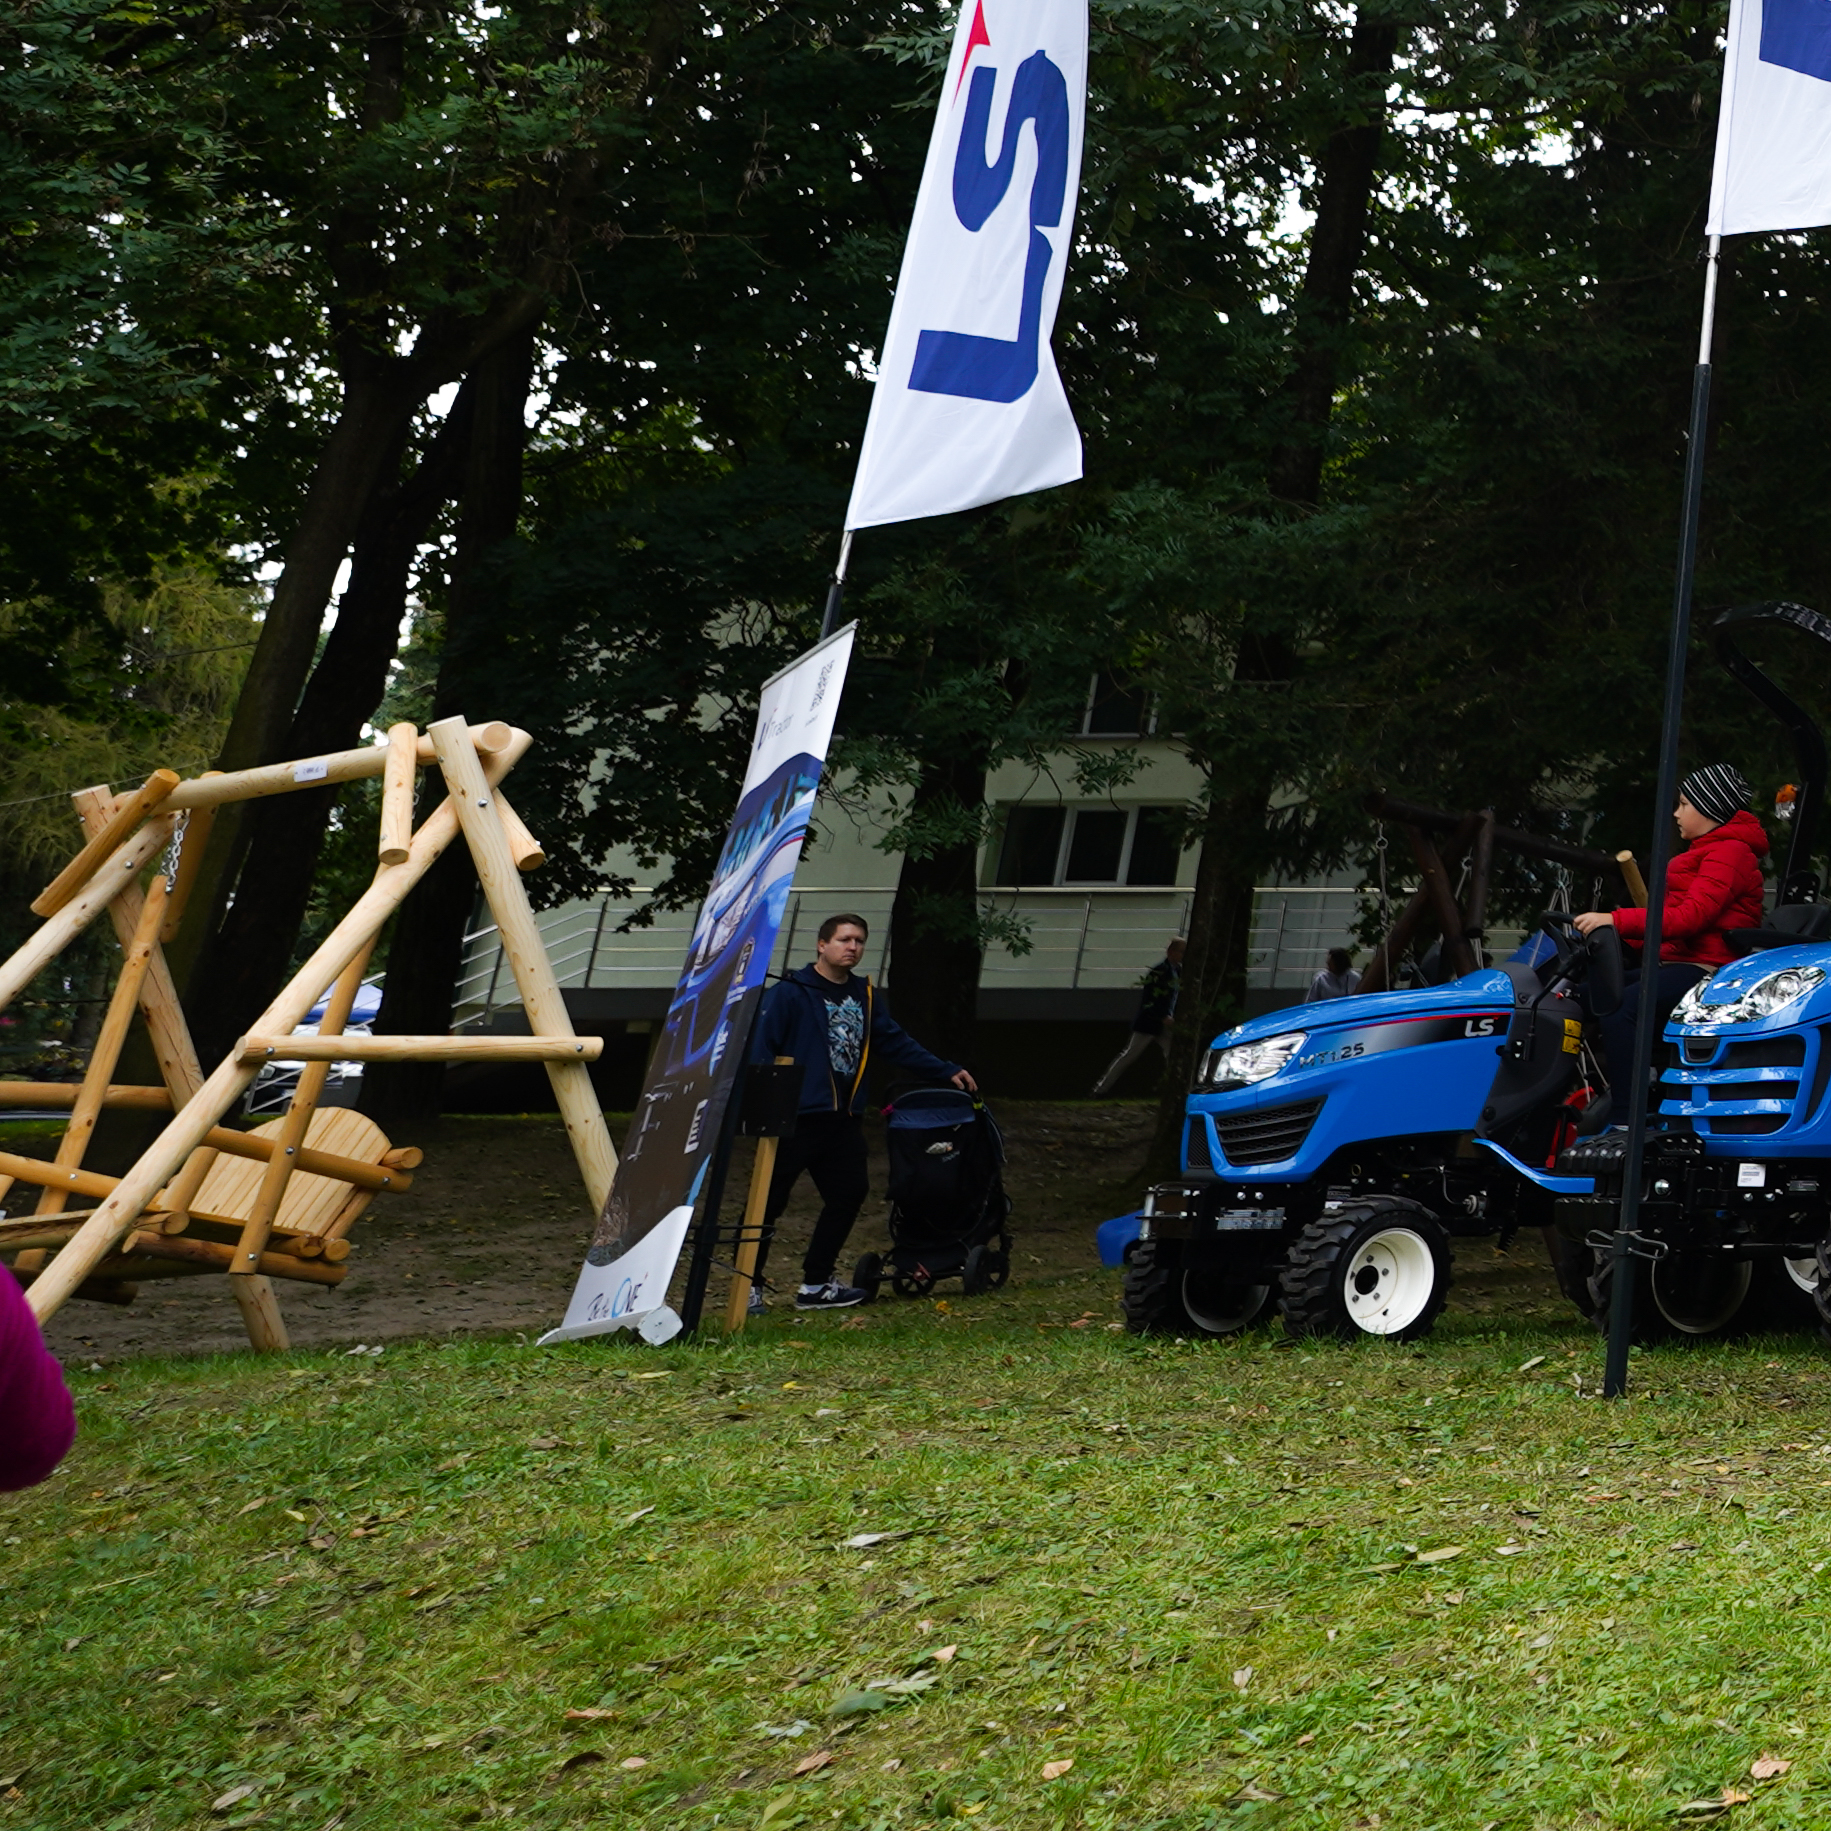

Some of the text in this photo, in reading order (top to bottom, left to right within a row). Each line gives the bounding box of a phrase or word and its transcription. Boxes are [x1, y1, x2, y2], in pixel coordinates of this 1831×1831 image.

[908, 49, 1071, 403] LS
[1464, 1018, 1495, 1038] LS
[1300, 1042, 1365, 1069] MT1.25
